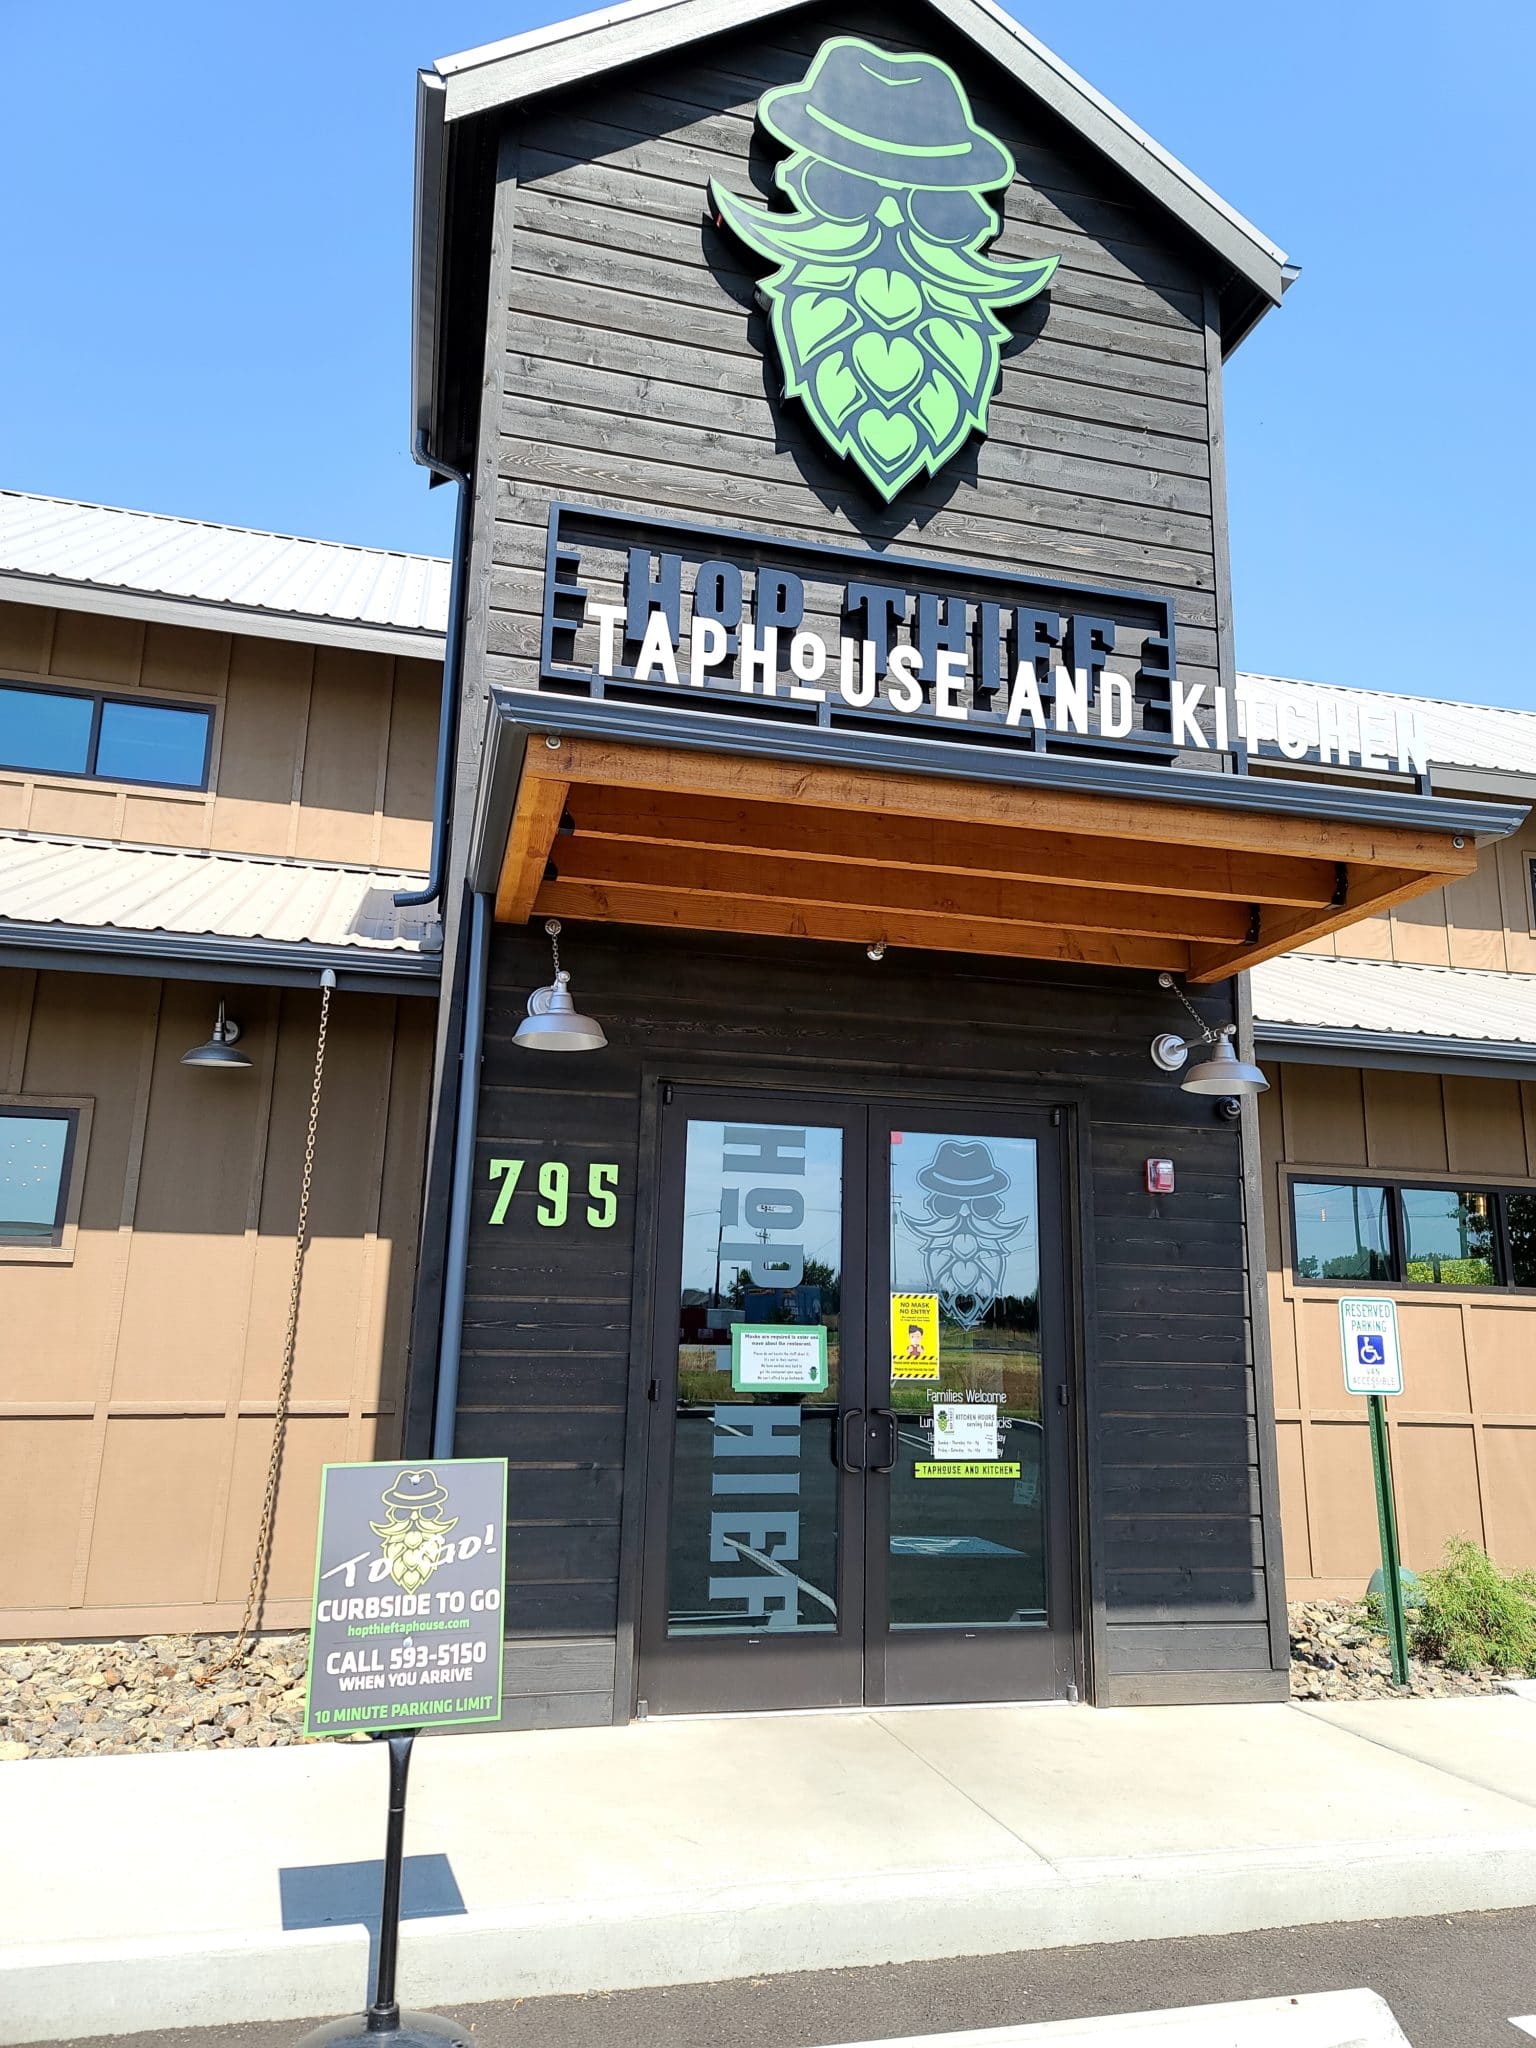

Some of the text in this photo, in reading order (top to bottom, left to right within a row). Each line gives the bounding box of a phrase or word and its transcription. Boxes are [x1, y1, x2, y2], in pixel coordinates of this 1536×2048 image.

[626, 547, 1116, 702] HOP THIEF
[587, 602, 1428, 776] TAPHOUSE AND KITCHEN
[488, 1158, 619, 1228] 795
[1344, 1303, 1391, 1318] RESERVED
[1351, 1319, 1387, 1332] PARKING
[709, 1125, 806, 1627] HOP HIEF
[926, 1388, 1007, 1403] Families Welcome
[922, 1465, 1013, 1475] TAPHOUSE AND KITCHEN
[317, 1589, 501, 1622] CURBSIDE TO GO
[347, 1618, 470, 1638] hopthieftaphouse.com
[326, 1641, 487, 1675] CALL 593-5150
[338, 1667, 473, 1691] WHEN YOU ARRIVE
[314, 1695, 493, 1724] 10 MINUTE PARKING LIMIT
